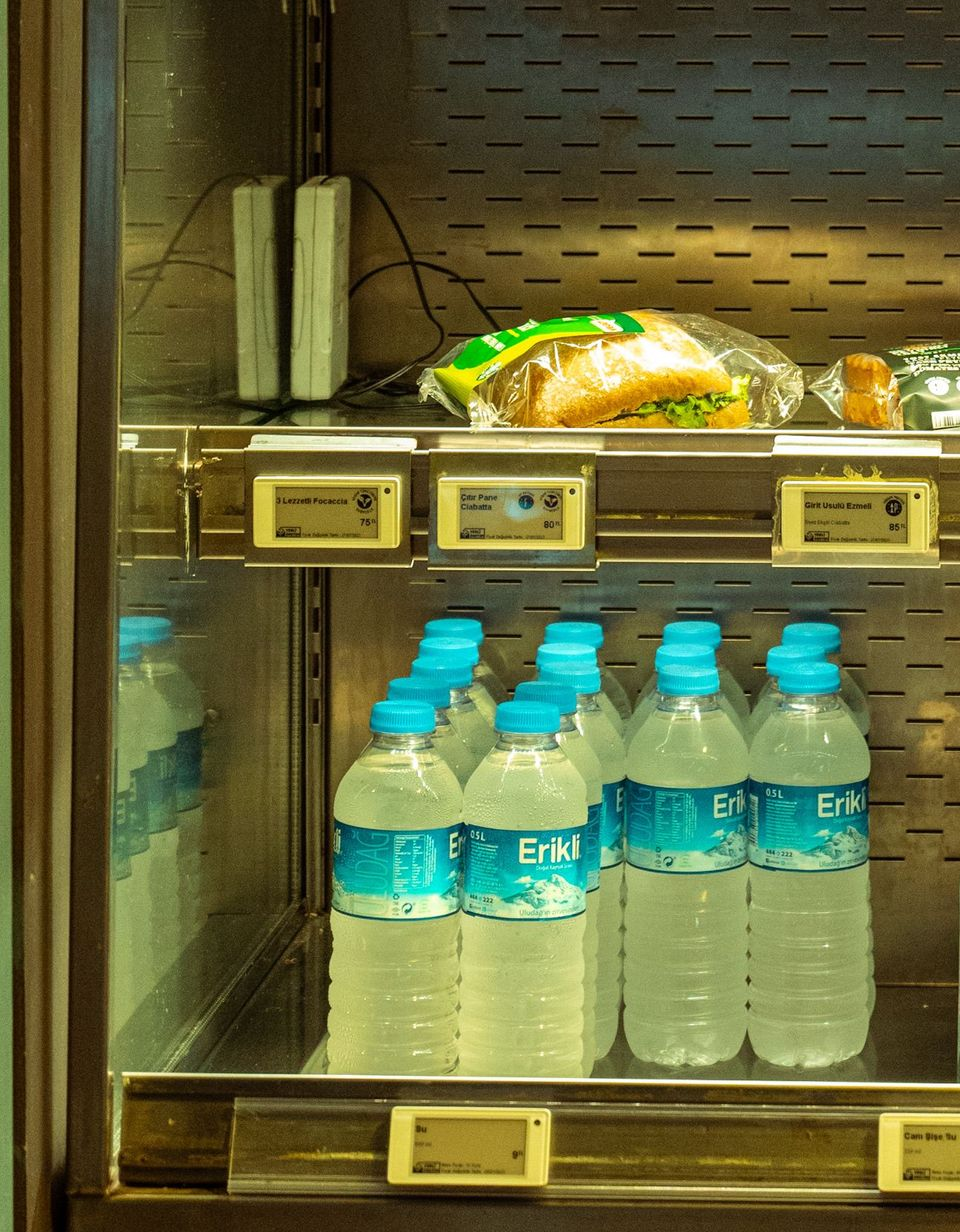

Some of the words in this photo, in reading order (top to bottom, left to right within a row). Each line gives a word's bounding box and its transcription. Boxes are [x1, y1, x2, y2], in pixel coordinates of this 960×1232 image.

[360, 518, 370, 526] 75
[889, 523, 899, 531] 85
[518, 833, 581, 864] Erikli
[415, 1125, 427, 1133] Su
[946, 1133, 957, 1141] Su
[512, 1150, 518, 1159] 9
